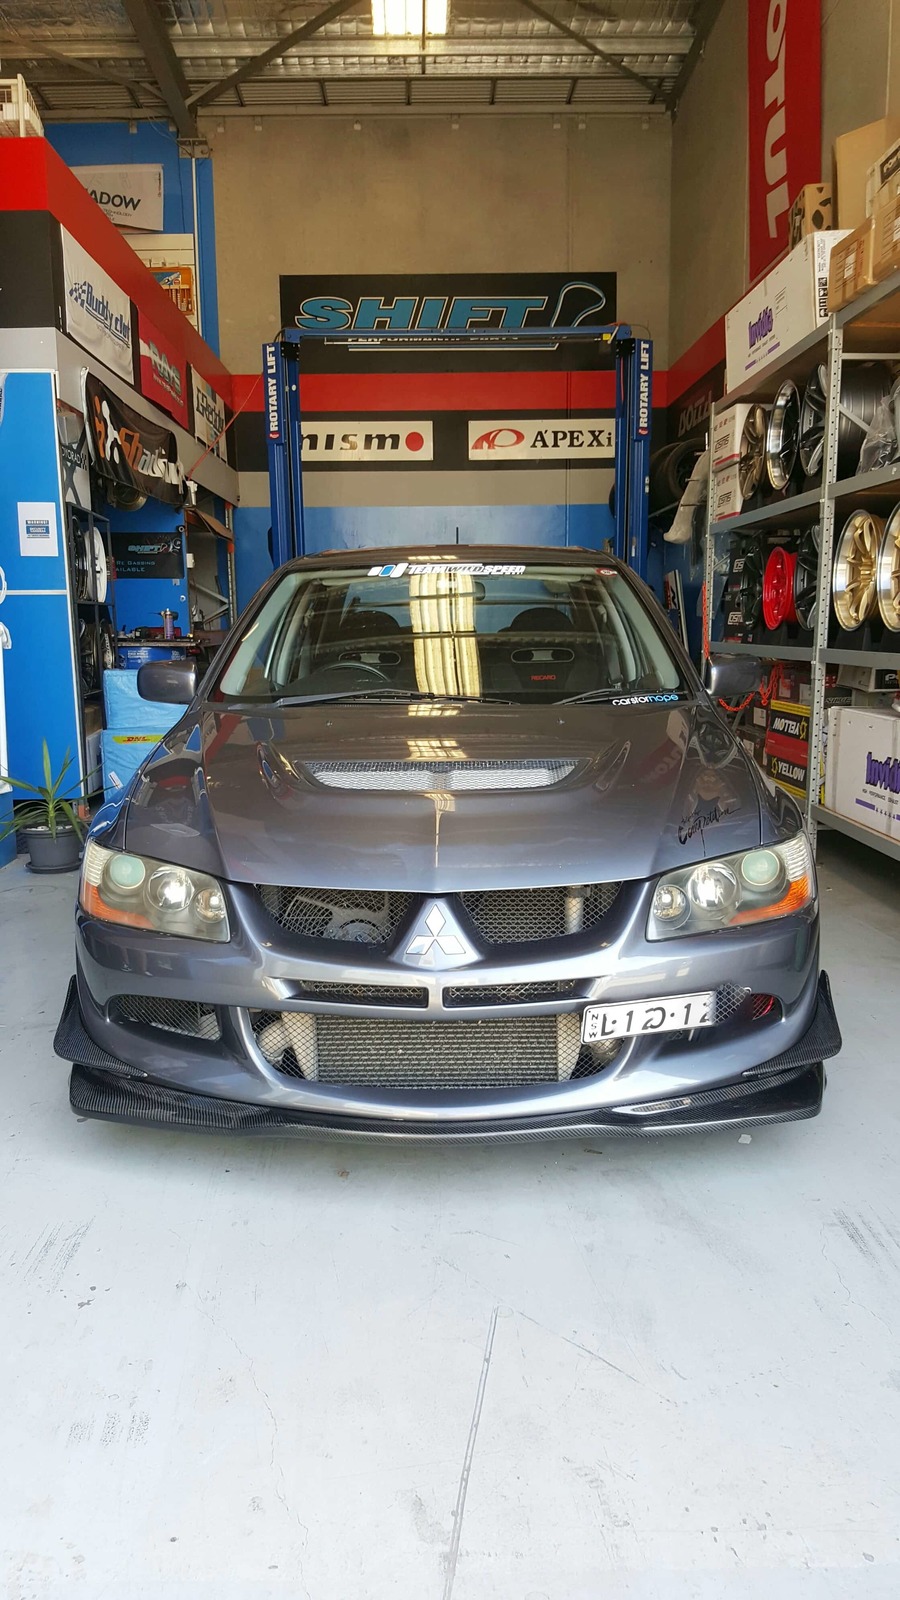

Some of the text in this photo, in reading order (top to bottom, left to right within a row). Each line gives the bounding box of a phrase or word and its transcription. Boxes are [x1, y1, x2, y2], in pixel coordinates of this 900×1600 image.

[764, 0, 790, 238] OTUL
[88, 189, 141, 211] ADOW
[295, 296, 549, 329] SHIFT
[266, 345, 277, 374] LIFT
[640, 341, 650, 370] LIFT
[267, 377, 279, 432] ROTARY
[639, 373, 649, 428] ROTARY
